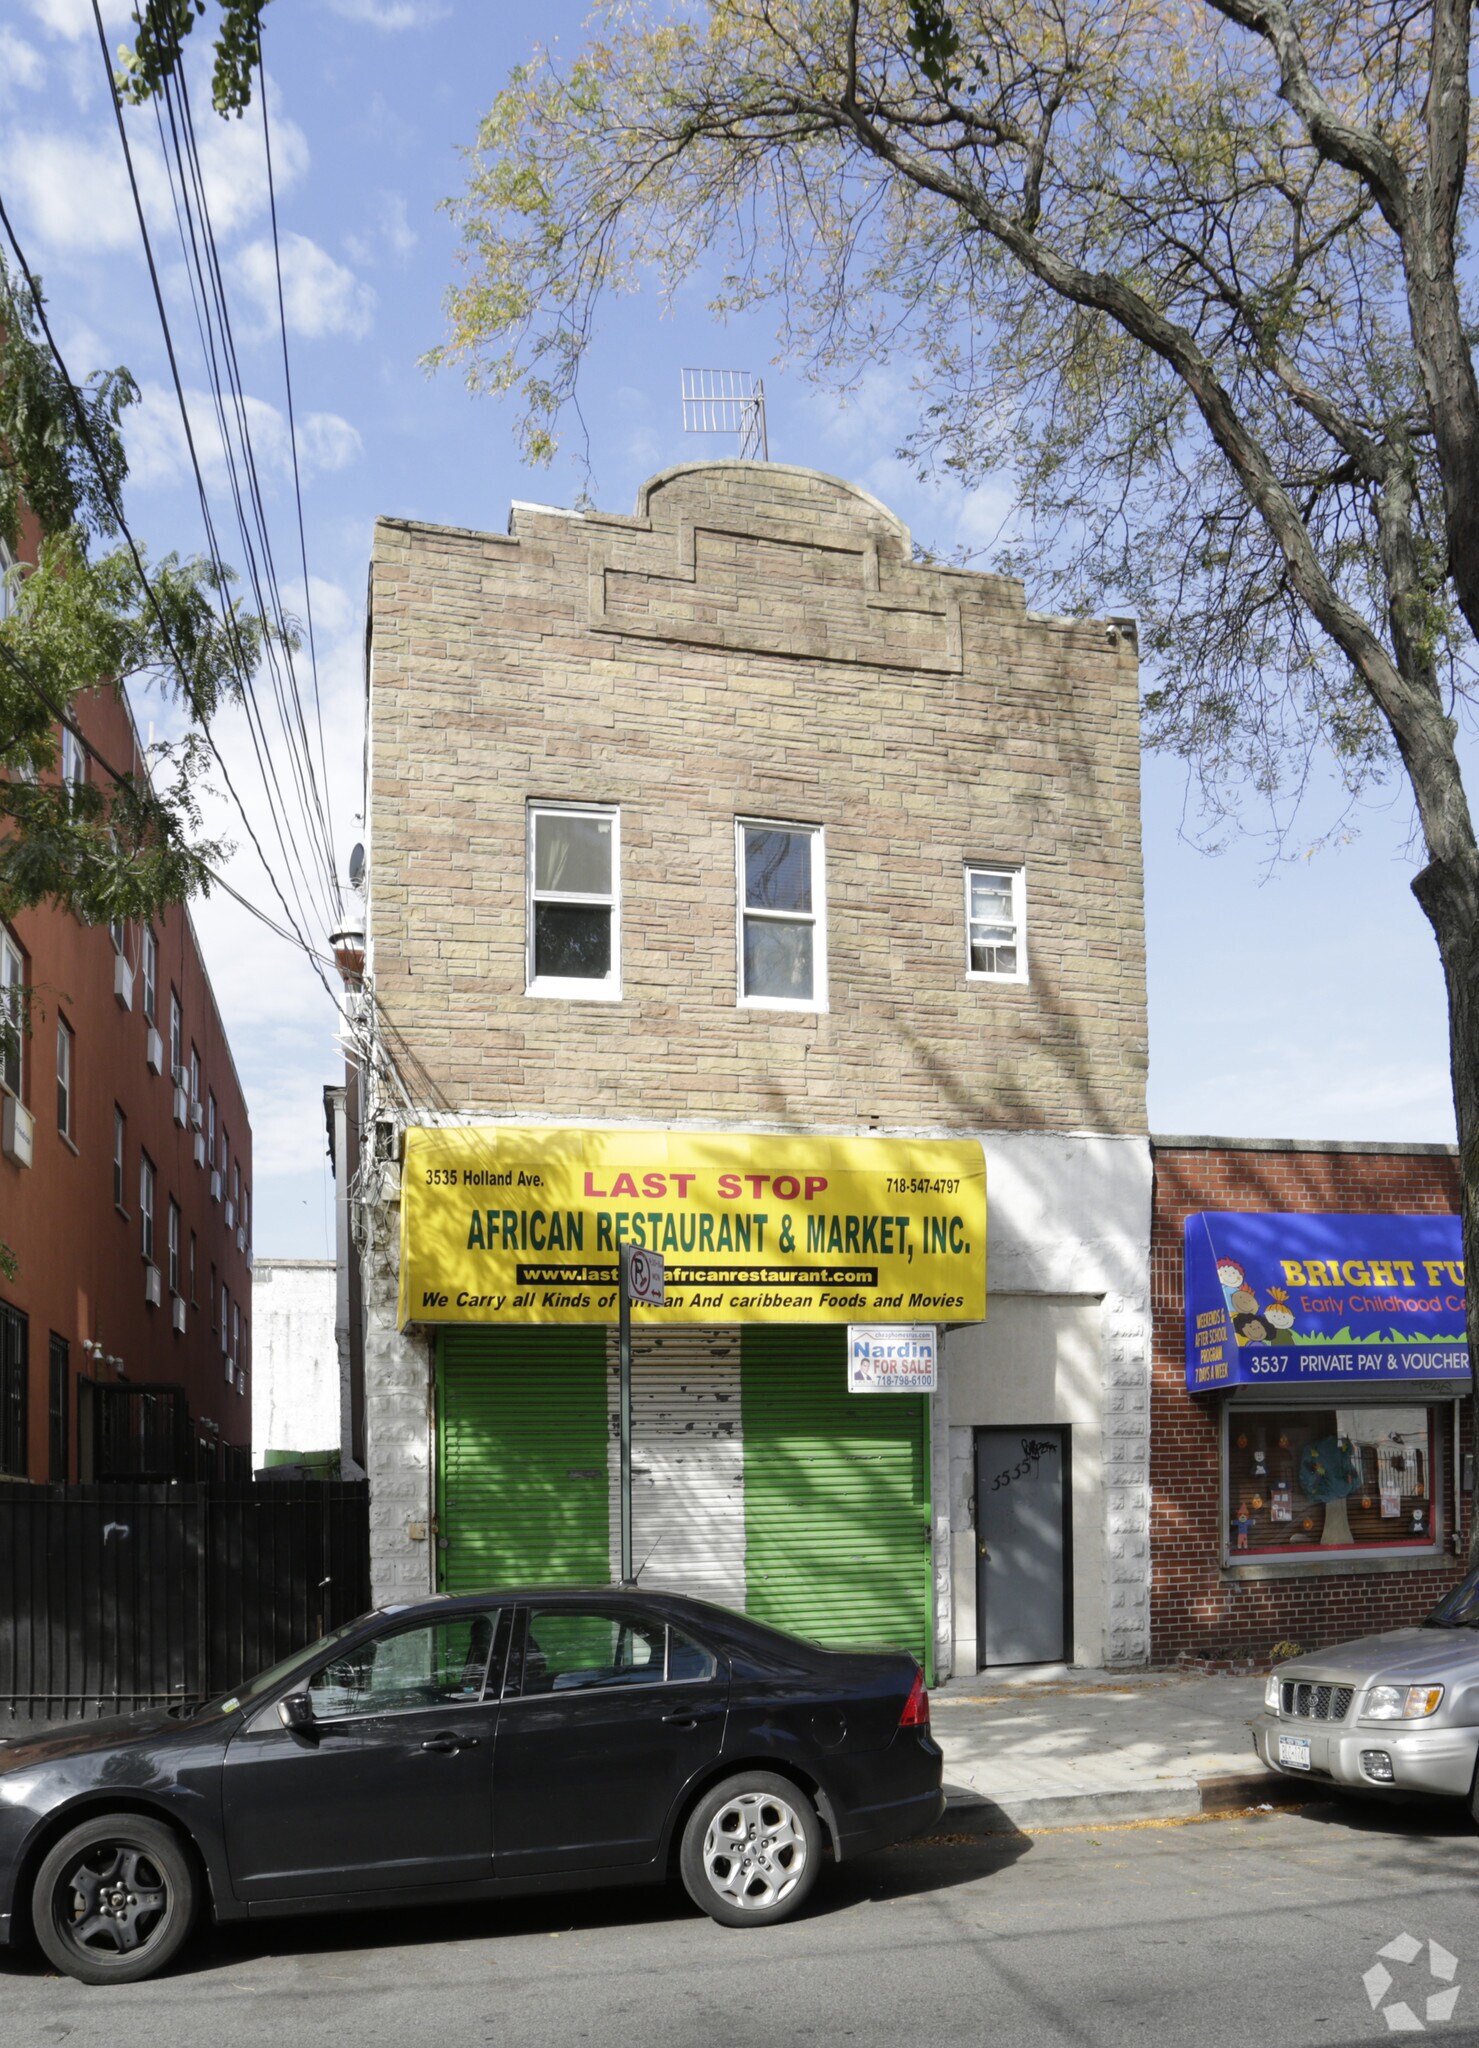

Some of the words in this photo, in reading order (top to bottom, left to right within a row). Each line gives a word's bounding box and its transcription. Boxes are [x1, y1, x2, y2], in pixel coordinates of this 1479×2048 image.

[425, 1169, 458, 1185] 3535
[463, 1169, 512, 1186] Holland
[517, 1170, 544, 1187] Ave.
[584, 1171, 696, 1199] LAST
[717, 1174, 829, 1201] STOP
[886, 1178, 960, 1194] 718-547-4797
[467, 1209, 583, 1250] AFRICAN
[597, 1211, 768, 1252] RESTAURANT
[778, 1213, 796, 1254] &
[806, 1214, 913, 1265] MARKET,
[923, 1215, 971, 1254] INC.
[1280, 1260, 1416, 1287] BRIGHT
[422, 1291, 449, 1307] We
[456, 1291, 506, 1311] Carry
[512, 1292, 536, 1307] all
[541, 1292, 591, 1308] Kinds
[597, 1292, 617, 1308] of
[689, 1293, 724, 1308] And
[729, 1293, 812, 1308] caribbean
[818, 1293, 867, 1308] Foods
[873, 1293, 904, 1308] and
[908, 1293, 964, 1308] Movies
[1300, 1295, 1344, 1316] Early
[1350, 1295, 1442, 1313] Childhood
[1194, 1330, 1209, 1348] AFTER
[1209, 1326, 1228, 1344] SCHOOL
[854, 1342, 932, 1358] Nardin
[1200, 1345, 1223, 1365] PROGRAM
[873, 1359, 898, 1374] FOR
[901, 1359, 932, 1374] SALE
[1198, 1365, 1211, 1383] DAYS
[1214, 1362, 1229, 1379] WEEK
[1250, 1356, 1289, 1374] 3537
[1300, 1354, 1353, 1372] PRIVATE
[1358, 1353, 1383, 1371] PAY
[1386, 1353, 1399, 1370] &
[876, 1375, 932, 1386] 718-798-6100
